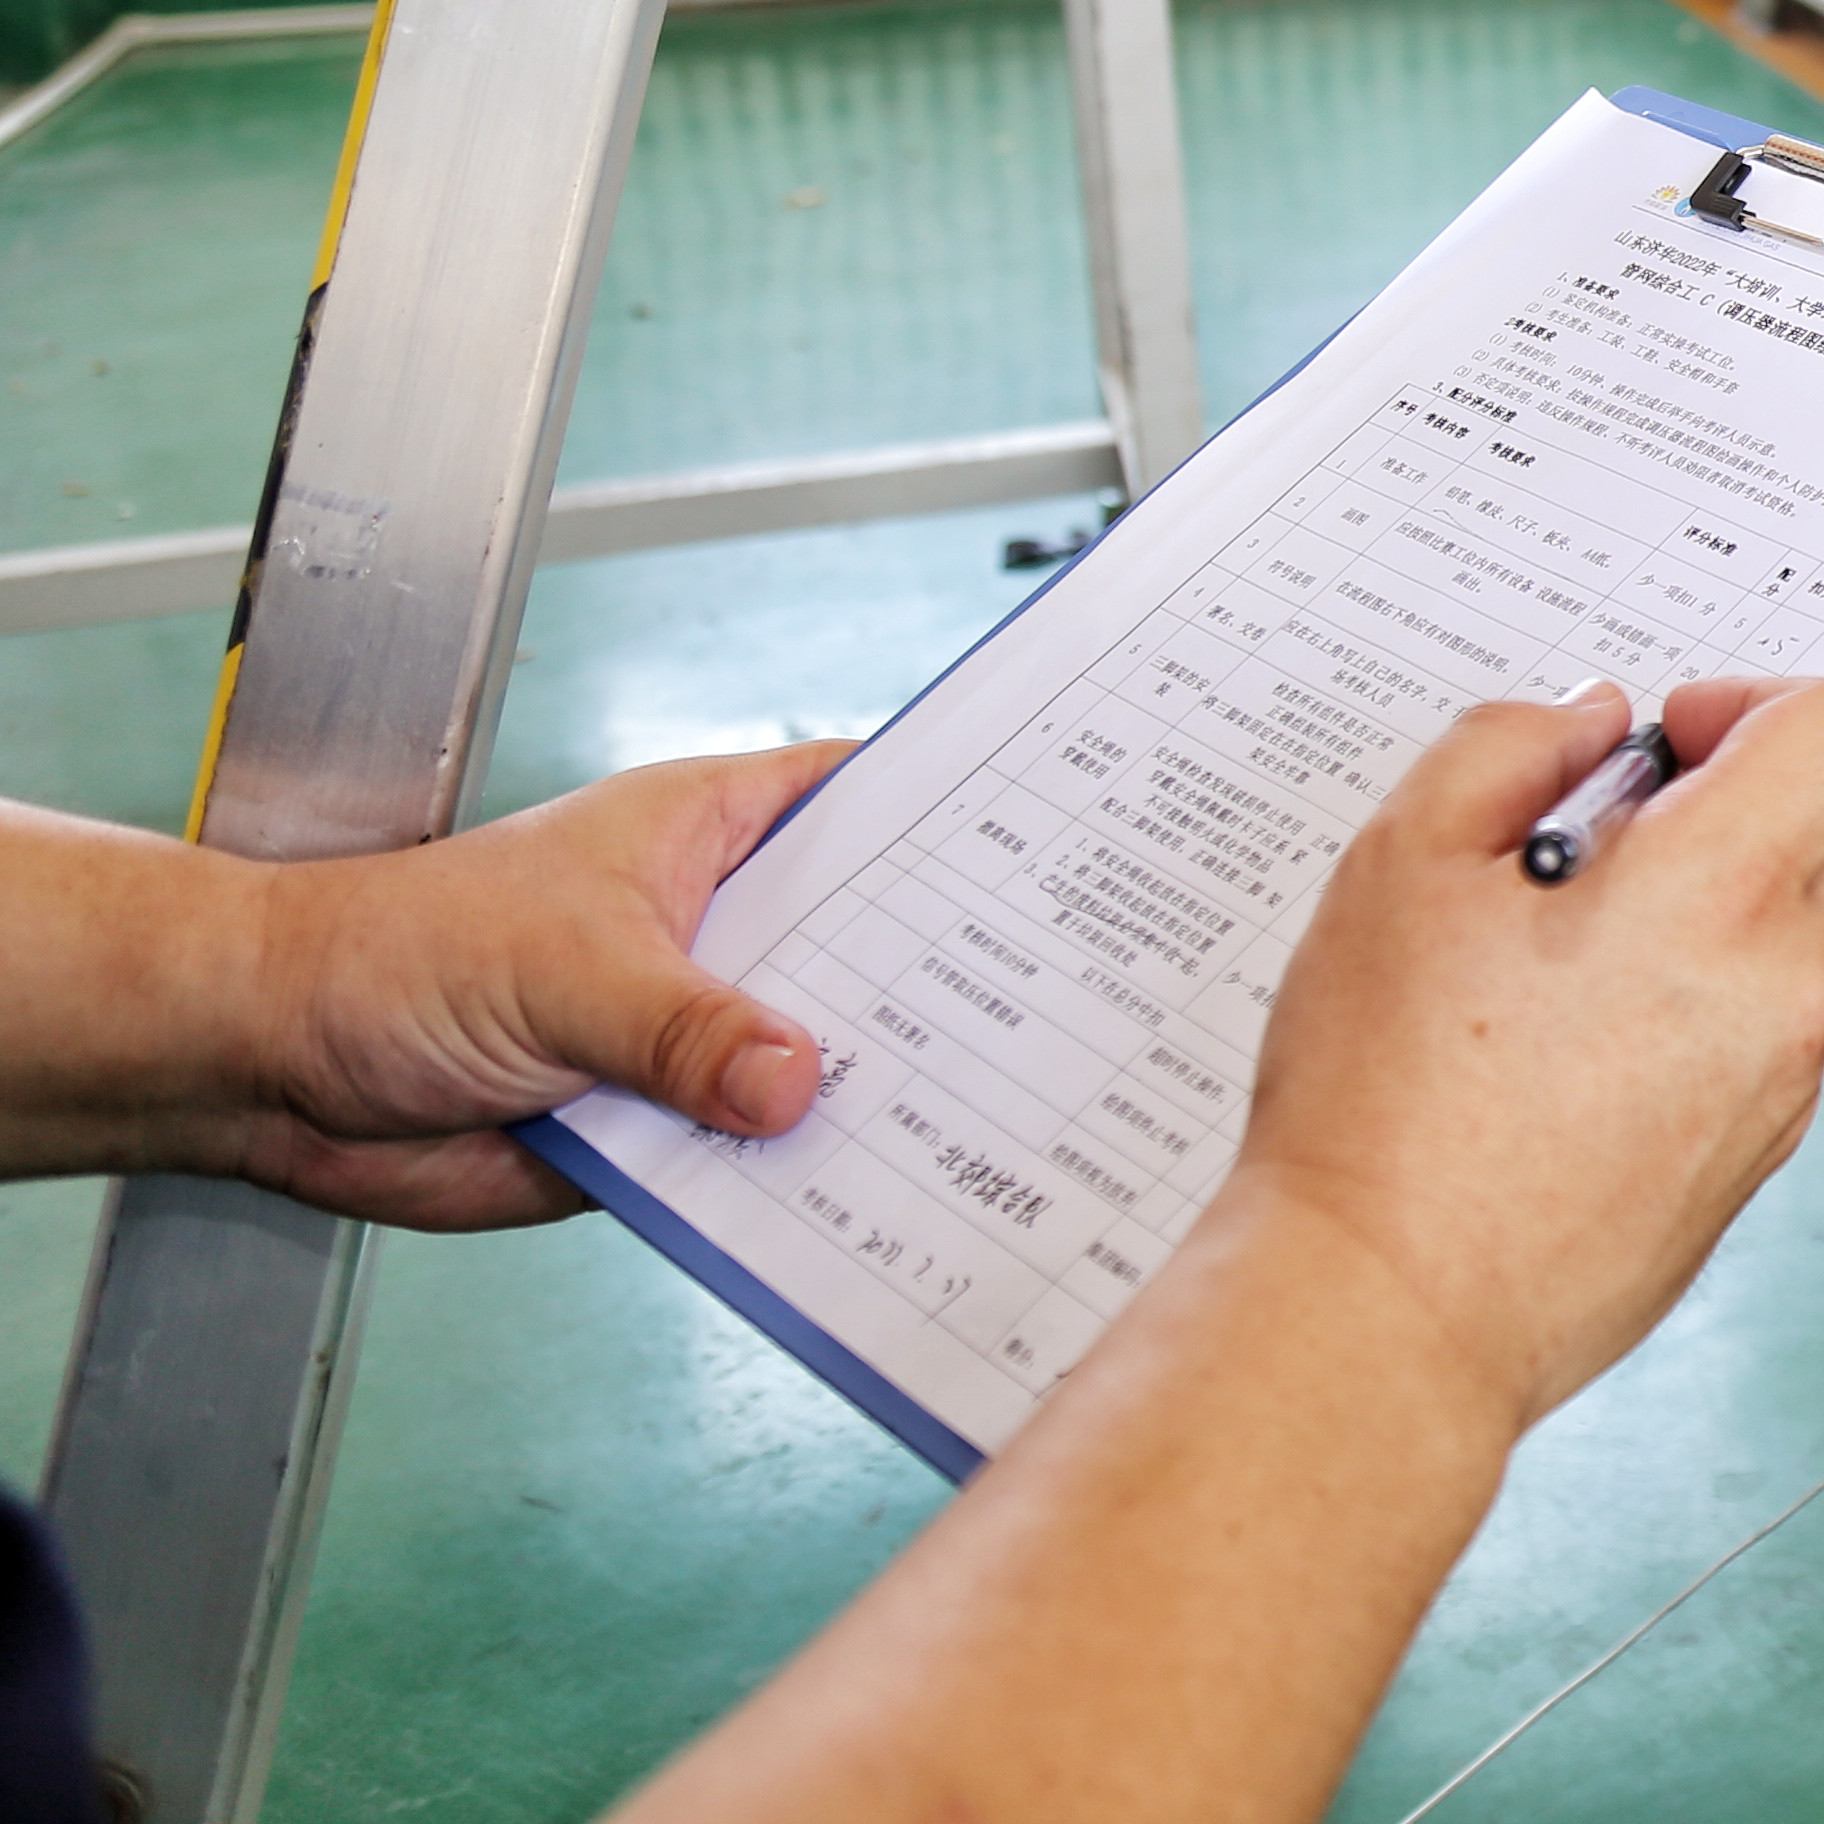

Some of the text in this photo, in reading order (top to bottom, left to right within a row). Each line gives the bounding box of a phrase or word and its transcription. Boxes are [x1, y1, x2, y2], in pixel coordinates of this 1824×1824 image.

[1616, 260, 1702, 303] 管网综合工
[1376, 454, 1433, 487] 准备工作
[1388, 397, 1421, 418] 序号
[1418, 409, 1474, 441] 考核内容
[1484, 438, 1540, 470] 考核要求
[1677, 523, 1742, 559] 评分标准
[1263, 557, 1319, 591] 符号说明
